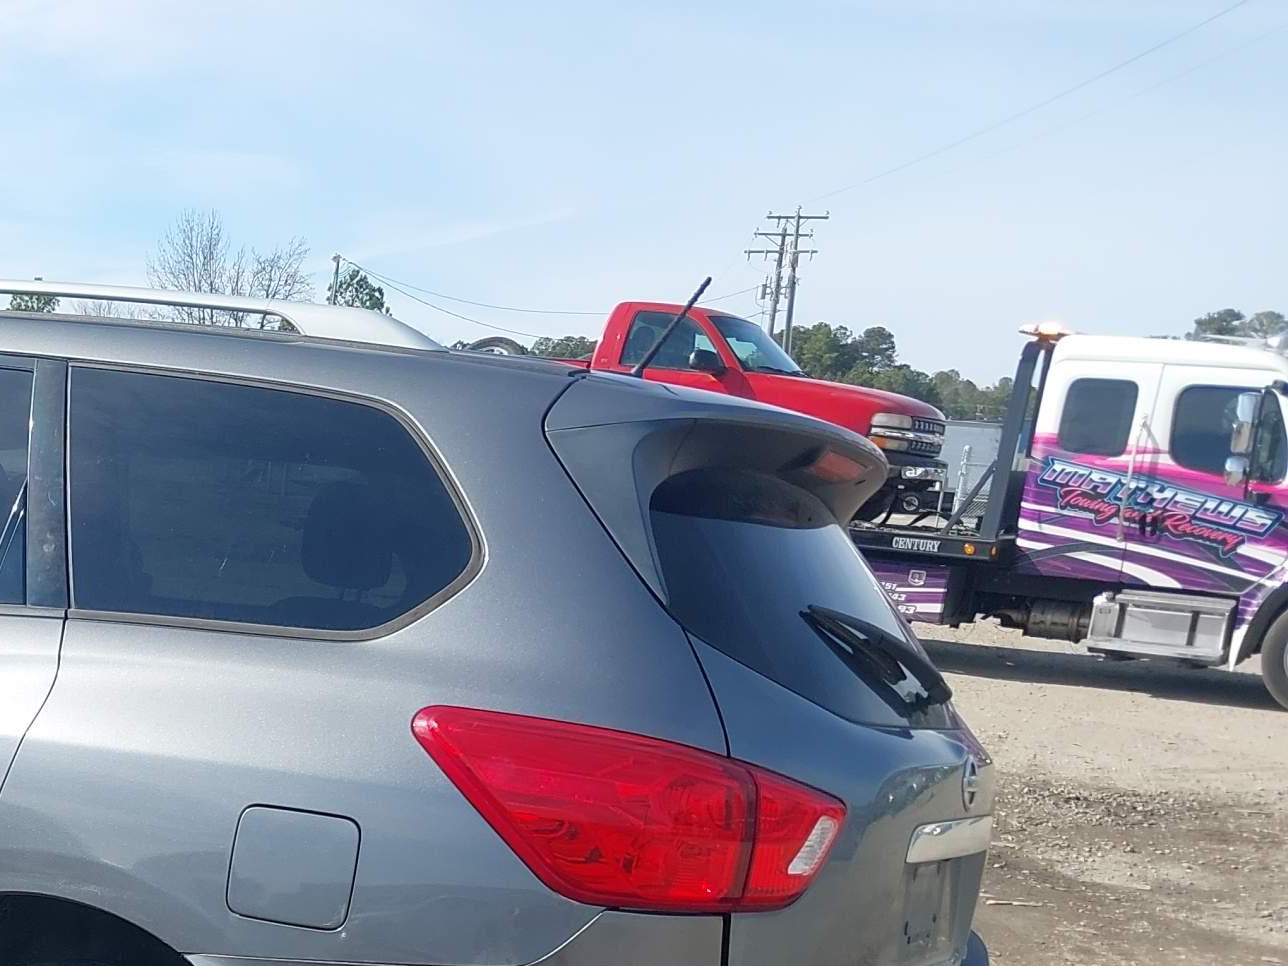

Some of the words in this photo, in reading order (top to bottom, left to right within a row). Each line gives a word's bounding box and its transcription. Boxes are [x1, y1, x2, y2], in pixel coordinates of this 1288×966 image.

[1043, 461, 1278, 532] MATHEWS
[1060, 487, 1118, 520] Towing
[1161, 511, 1242, 552] Recovery
[892, 536, 942, 552] CENTURY
